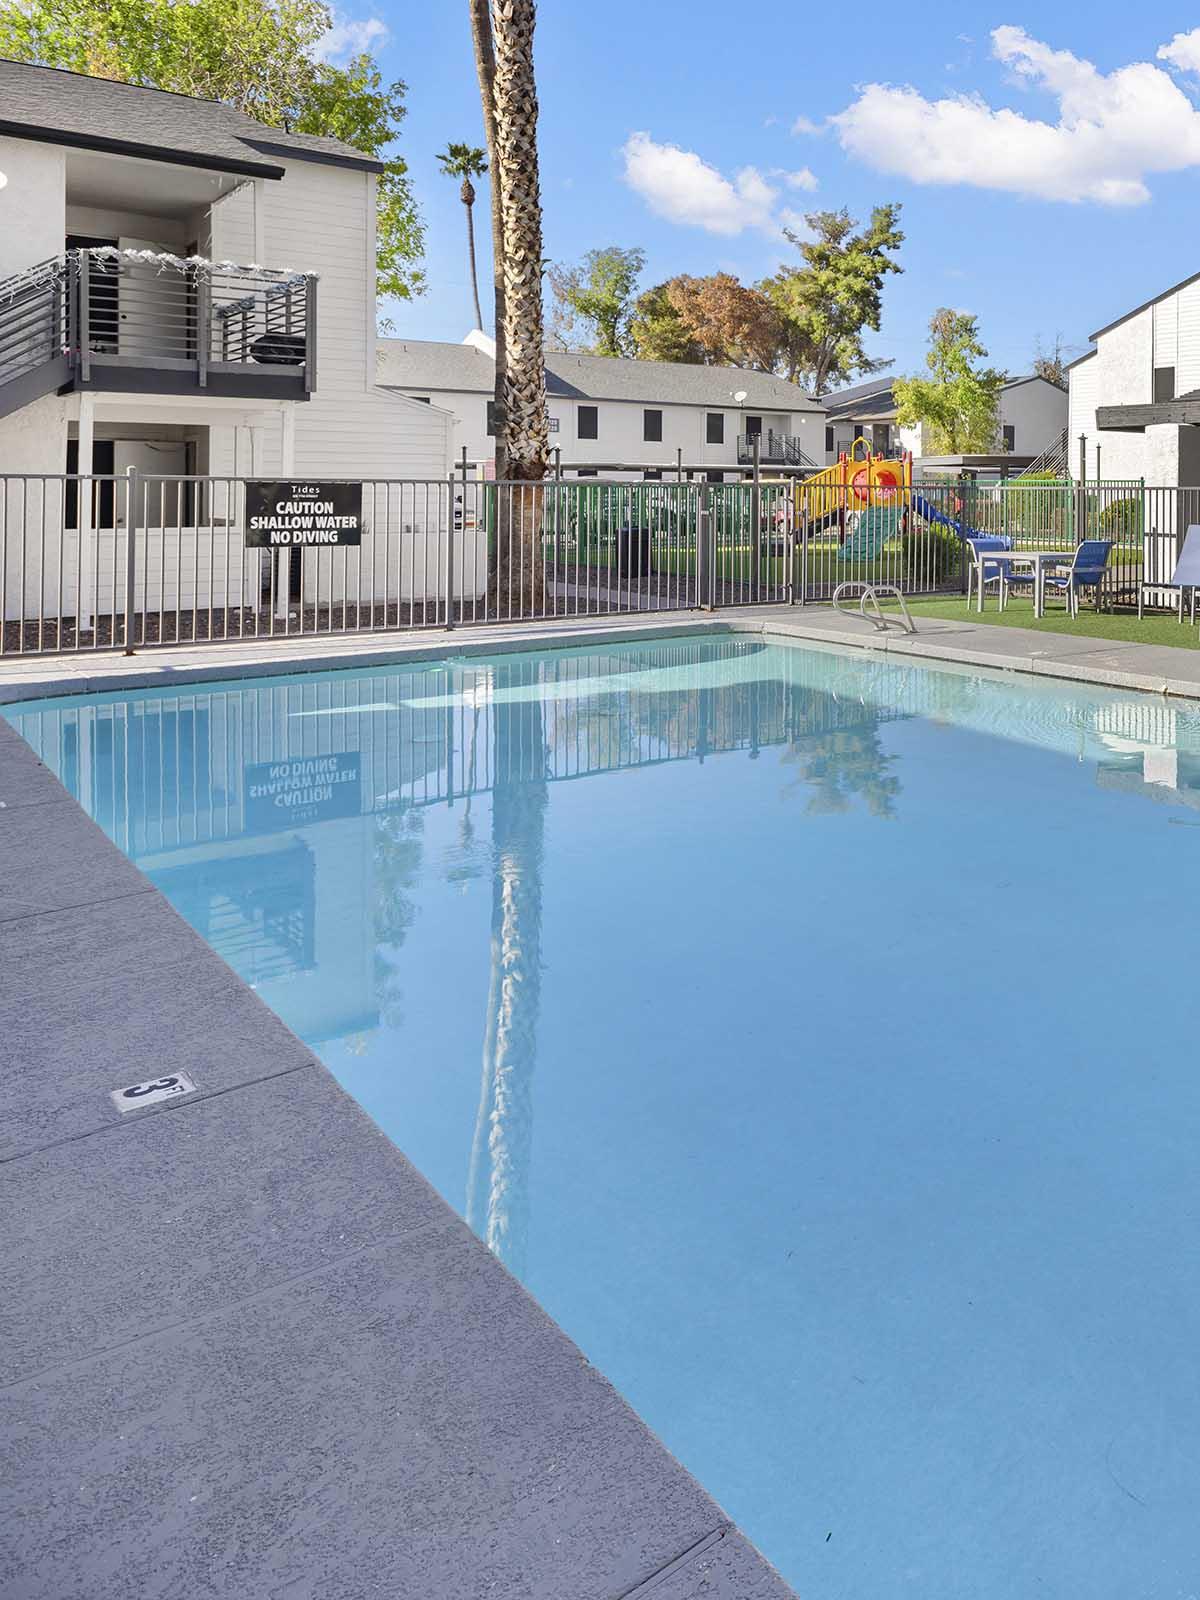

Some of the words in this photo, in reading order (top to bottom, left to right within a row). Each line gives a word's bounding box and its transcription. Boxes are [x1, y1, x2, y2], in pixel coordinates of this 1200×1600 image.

[292, 485, 320, 494] Tides
[276, 501, 334, 515] CAUTION
[250, 516, 316, 529] SHALLOW
[316, 516, 357, 529] WATER
[270, 531, 291, 544] NO
[293, 530, 338, 544] DIVING
[123, 1077, 179, 1098] 3
